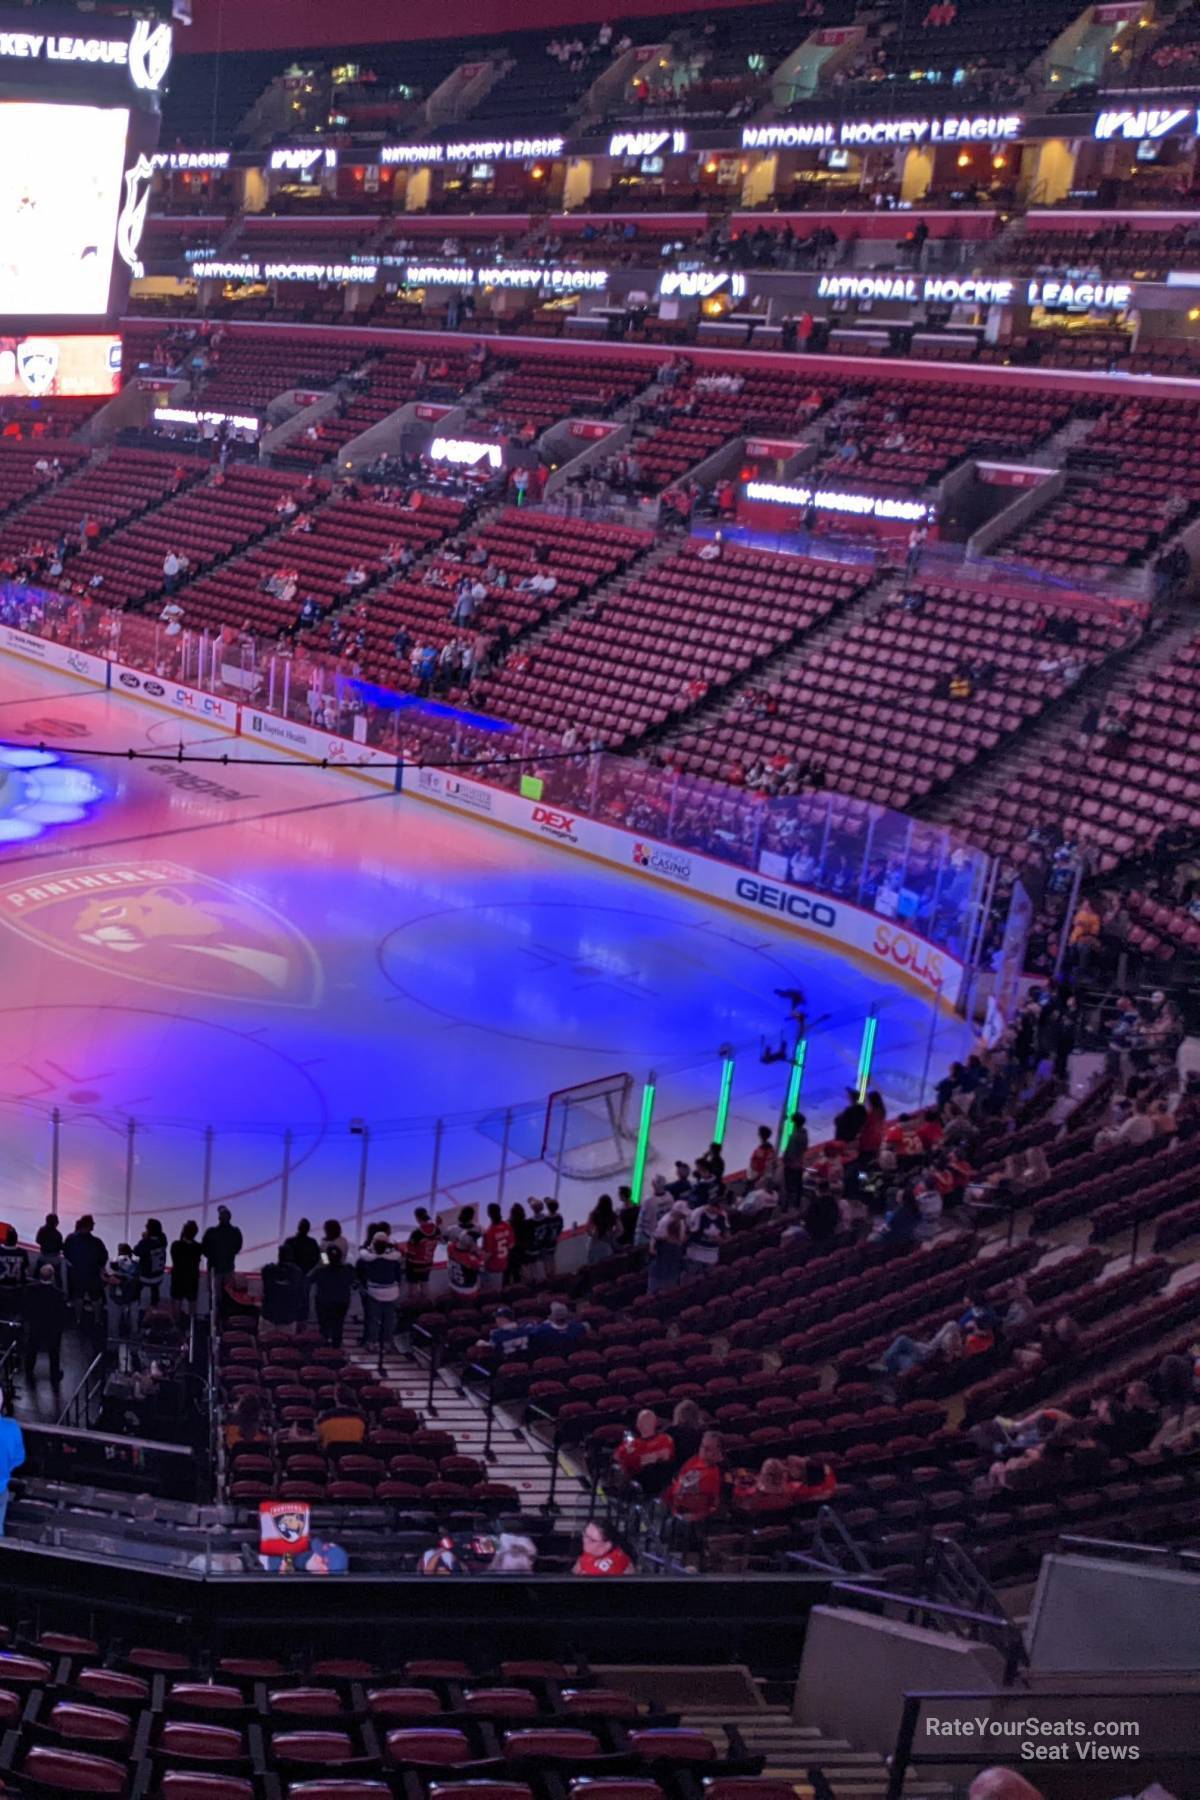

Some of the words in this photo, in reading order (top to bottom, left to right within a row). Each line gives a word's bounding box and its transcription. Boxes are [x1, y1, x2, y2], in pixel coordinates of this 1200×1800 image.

[46, 36, 128, 65] LEAGUE
[742, 126, 836, 149] NATIONAL
[840, 121, 929, 145] HOCKEY
[931, 117, 1021, 141] LEAGUE
[169, 152, 230, 169] LEAGUE
[382, 144, 444, 164] NATIONAL
[447, 141, 503, 161] HOCKEY
[505, 138, 565, 159] LEAGUE
[192, 263, 261, 281] NATIONAL
[265, 264, 325, 282] HOCKEY
[327, 266, 377, 284] LEAGUE
[406, 267, 474, 286] NATIONAL
[479, 269, 541, 288] HOCKEY
[543, 270, 608, 290] LEAGUE
[1028, 283, 1132, 308] LEAGUE
[531, 806, 575, 833] DEX
[651, 855, 690, 876] CASINO
[6, 867, 168, 908] PANTHERS
[736, 877, 836, 928] GEICO
[873, 923, 945, 988] SOLIS
